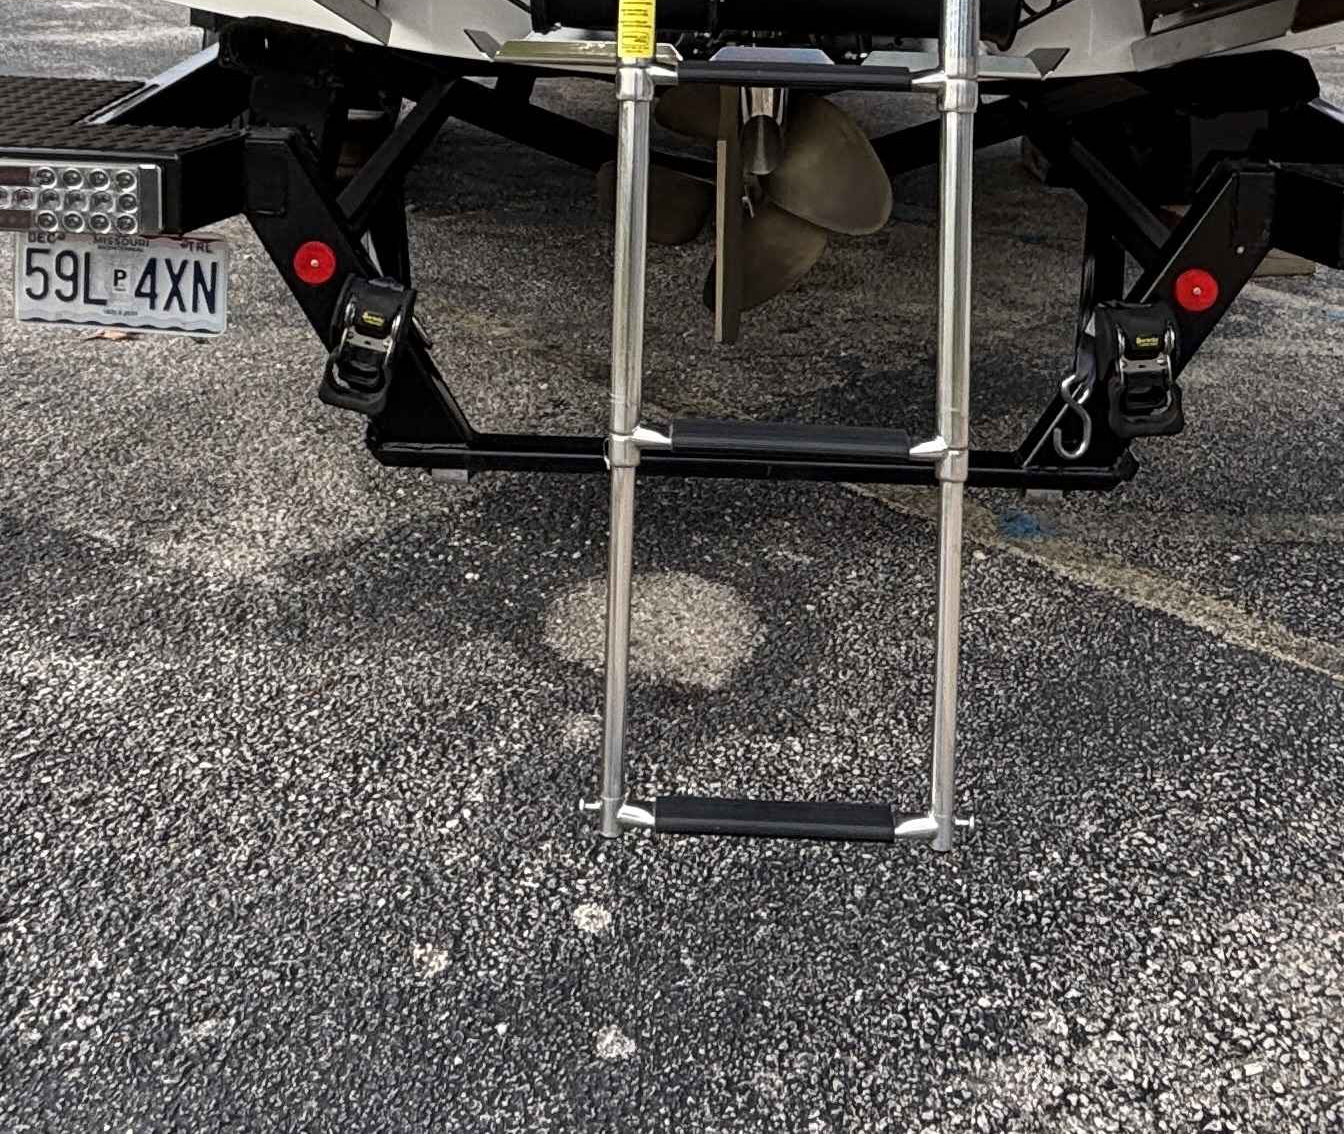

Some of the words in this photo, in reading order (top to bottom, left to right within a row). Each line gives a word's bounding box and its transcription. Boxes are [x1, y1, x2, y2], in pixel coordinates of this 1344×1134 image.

[93, 236, 149, 247] MISSOURI
[25, 247, 108, 306] 59L
[134, 257, 218, 314] 4XN
